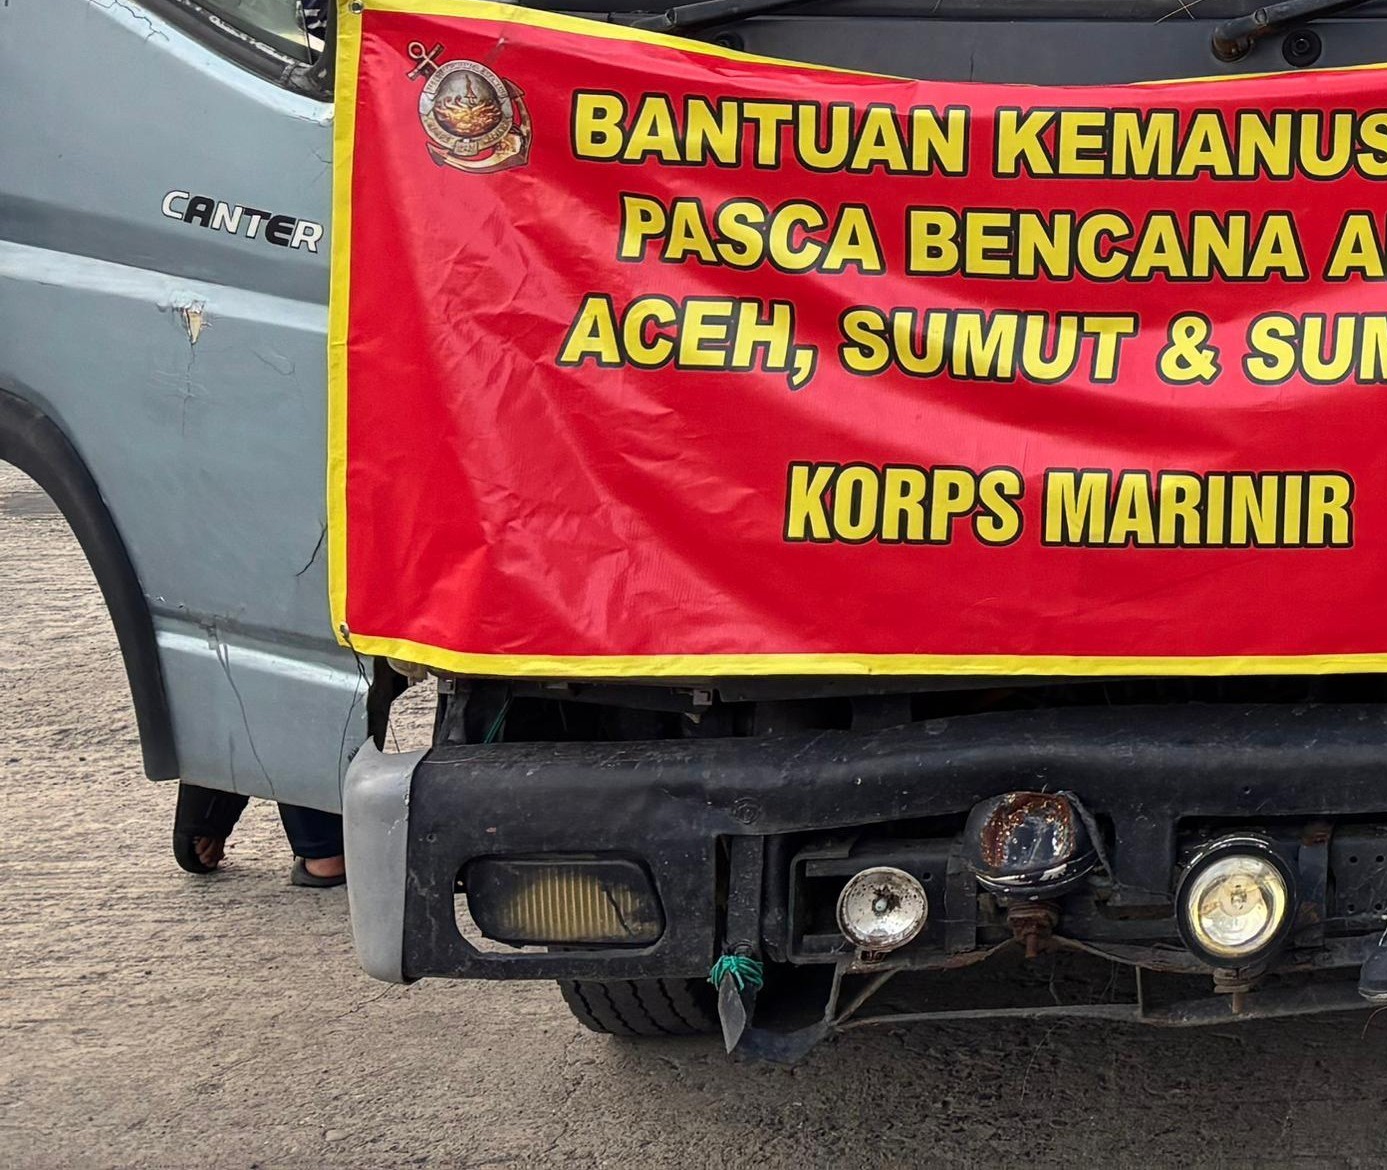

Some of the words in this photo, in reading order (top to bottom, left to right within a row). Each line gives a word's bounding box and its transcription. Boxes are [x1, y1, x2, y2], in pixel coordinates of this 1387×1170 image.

[569, 92, 970, 178] BANTUAN
[161, 189, 325, 254] CANTER
[616, 192, 886, 276] PASCA
[905, 205, 1310, 284] BENCANA
[557, 292, 817, 389] ACEH,
[838, 305, 1142, 386] SUMUT
[1158, 310, 1222, 385] &
[782, 460, 1025, 547] KORPS
[1040, 468, 1356, 550] MARINIR
